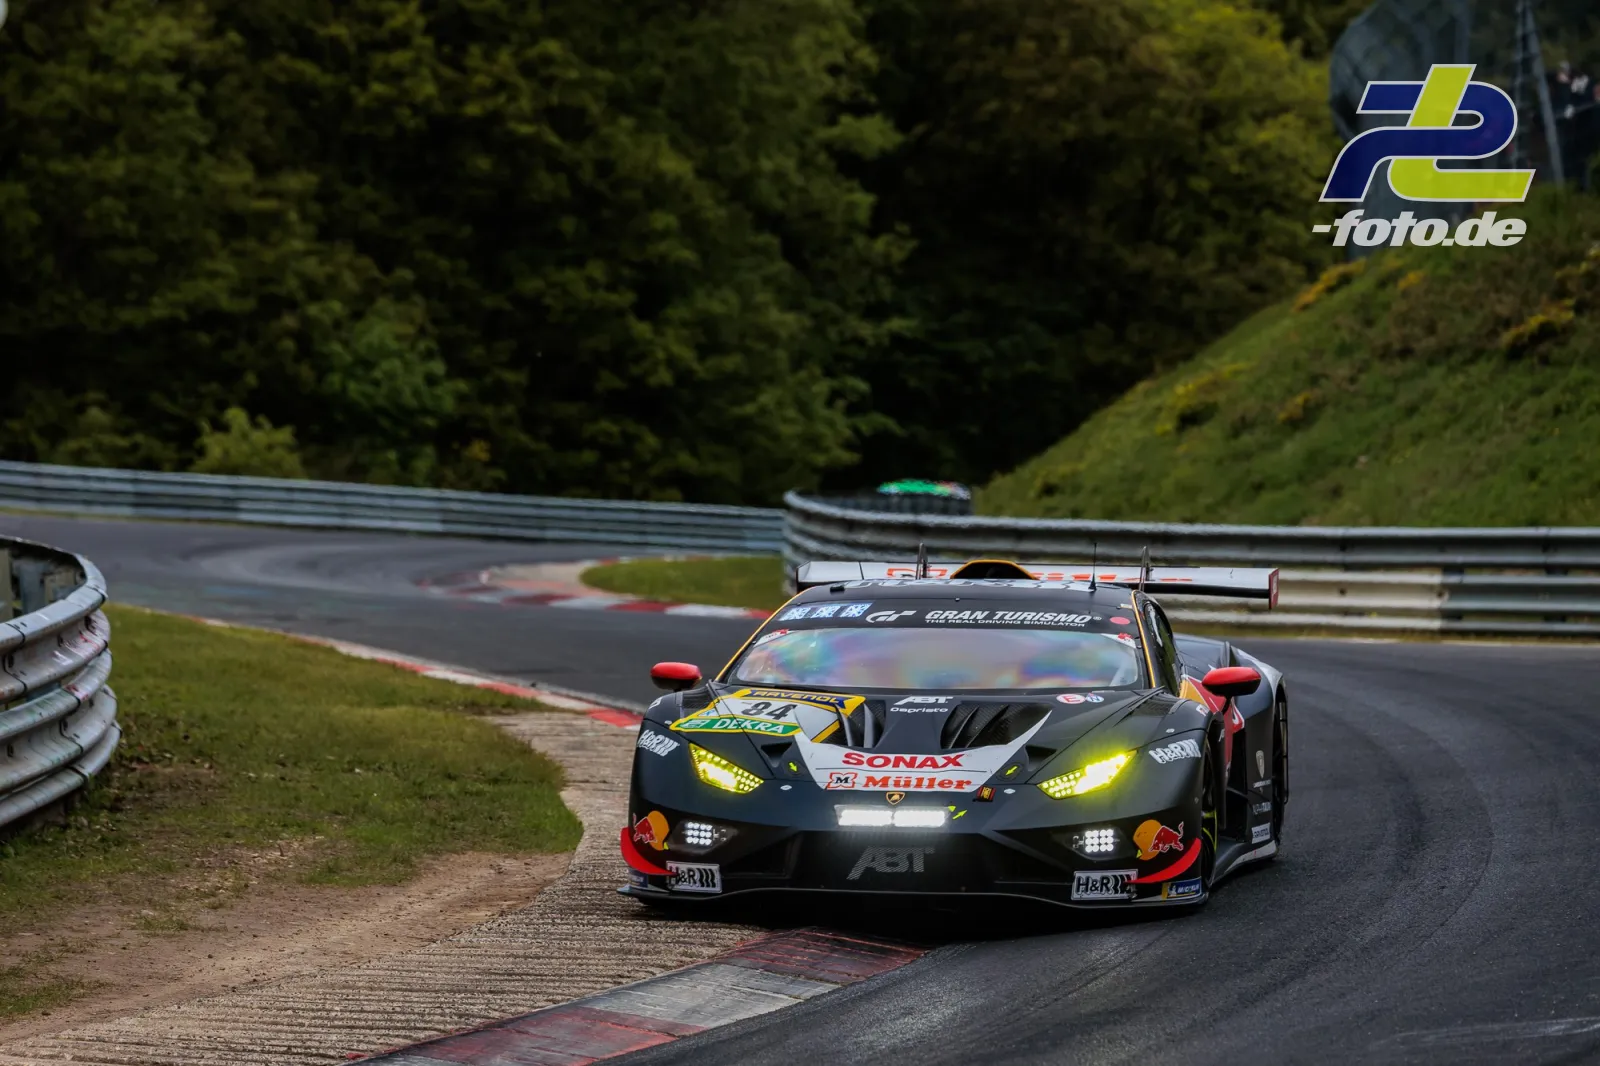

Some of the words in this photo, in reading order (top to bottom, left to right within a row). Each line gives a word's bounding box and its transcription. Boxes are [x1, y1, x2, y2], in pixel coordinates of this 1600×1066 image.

[925, 610, 990, 619] GRAN
[753, 690, 840, 703] RAVENOL
[894, 696, 953, 705] ABT
[741, 701, 798, 720] 84
[713, 716, 785, 734] DEKRA
[842, 752, 965, 769] SONAX
[862, 775, 972, 790] Müller
[846, 846, 935, 880] ABT
